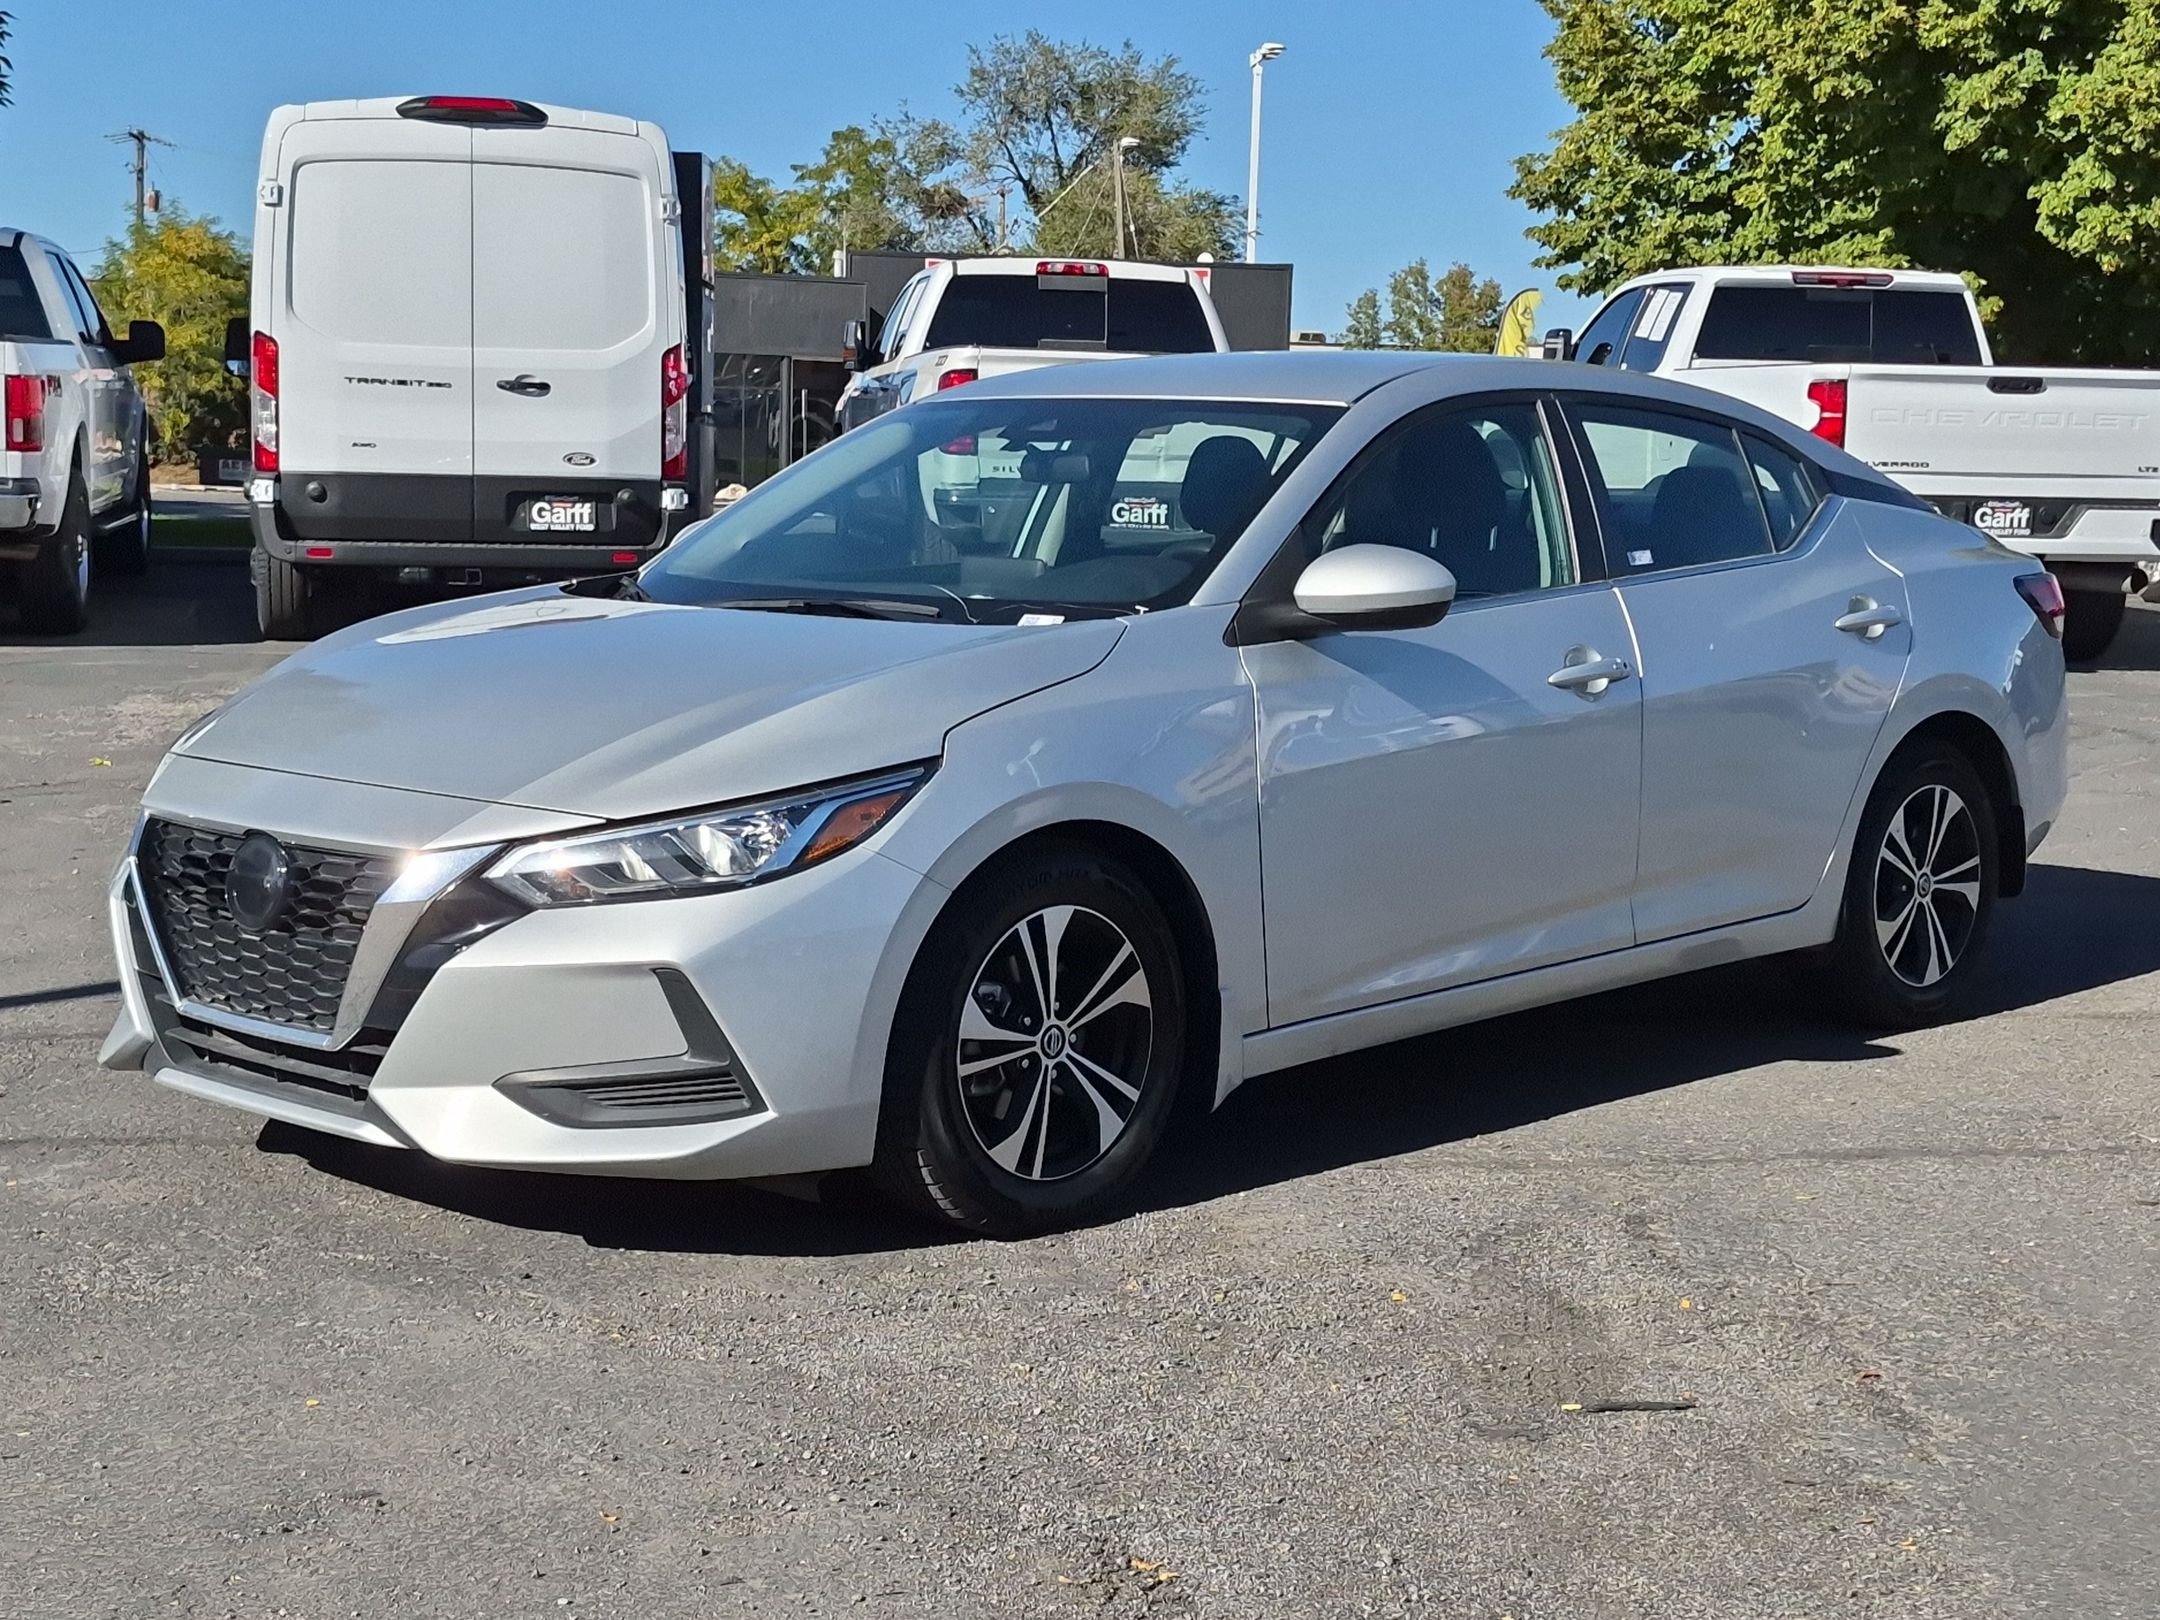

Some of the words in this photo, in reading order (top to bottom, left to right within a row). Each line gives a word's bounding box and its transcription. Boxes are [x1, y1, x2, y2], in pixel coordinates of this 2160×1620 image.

[343, 376, 426, 387] TRANSIT
[531, 501, 592, 524] Garff
[1111, 502, 1168, 525] Garff
[1974, 506, 2030, 528] Garff
